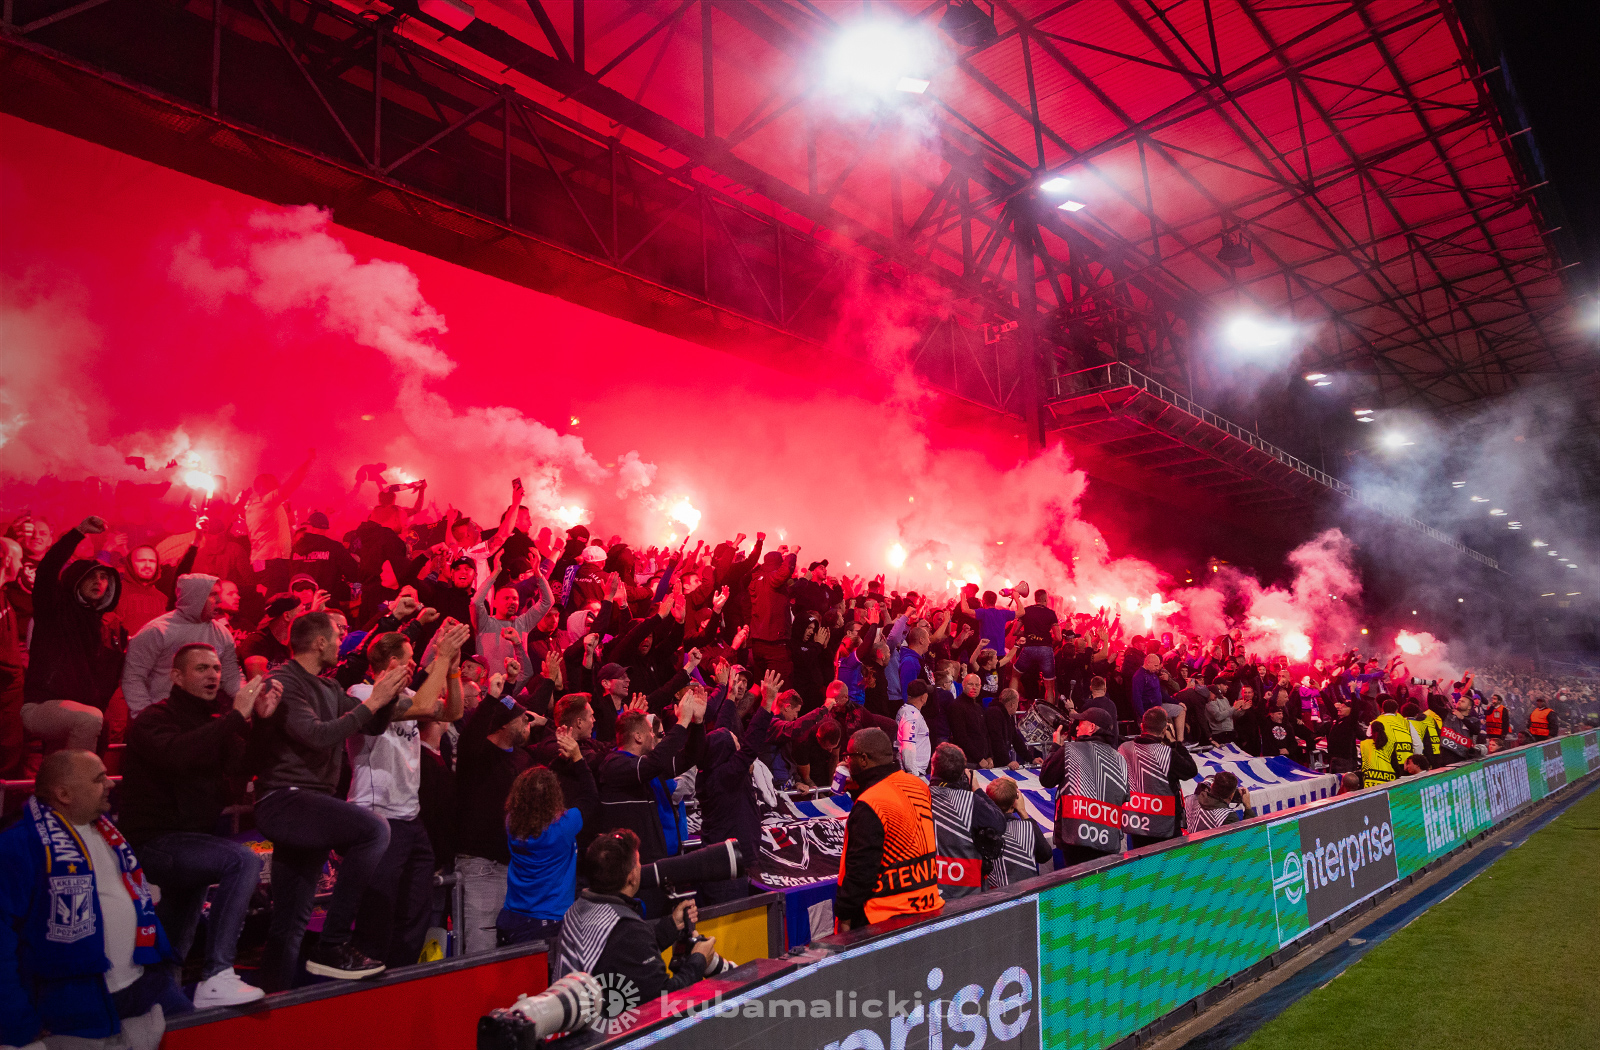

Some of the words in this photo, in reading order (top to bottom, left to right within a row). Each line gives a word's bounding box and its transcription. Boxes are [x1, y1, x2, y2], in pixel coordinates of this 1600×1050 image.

[1072, 799, 1119, 825] PHOTO
[1125, 795, 1163, 812] OTO
[1420, 781, 1455, 853] HERE
[1451, 774, 1475, 834] FOR
[1469, 768, 1491, 827] THE
[1484, 756, 1532, 818] DESTINATION
[1077, 823, 1109, 845] 006
[1121, 813, 1150, 831] 002
[1274, 815, 1393, 905] enterprise
